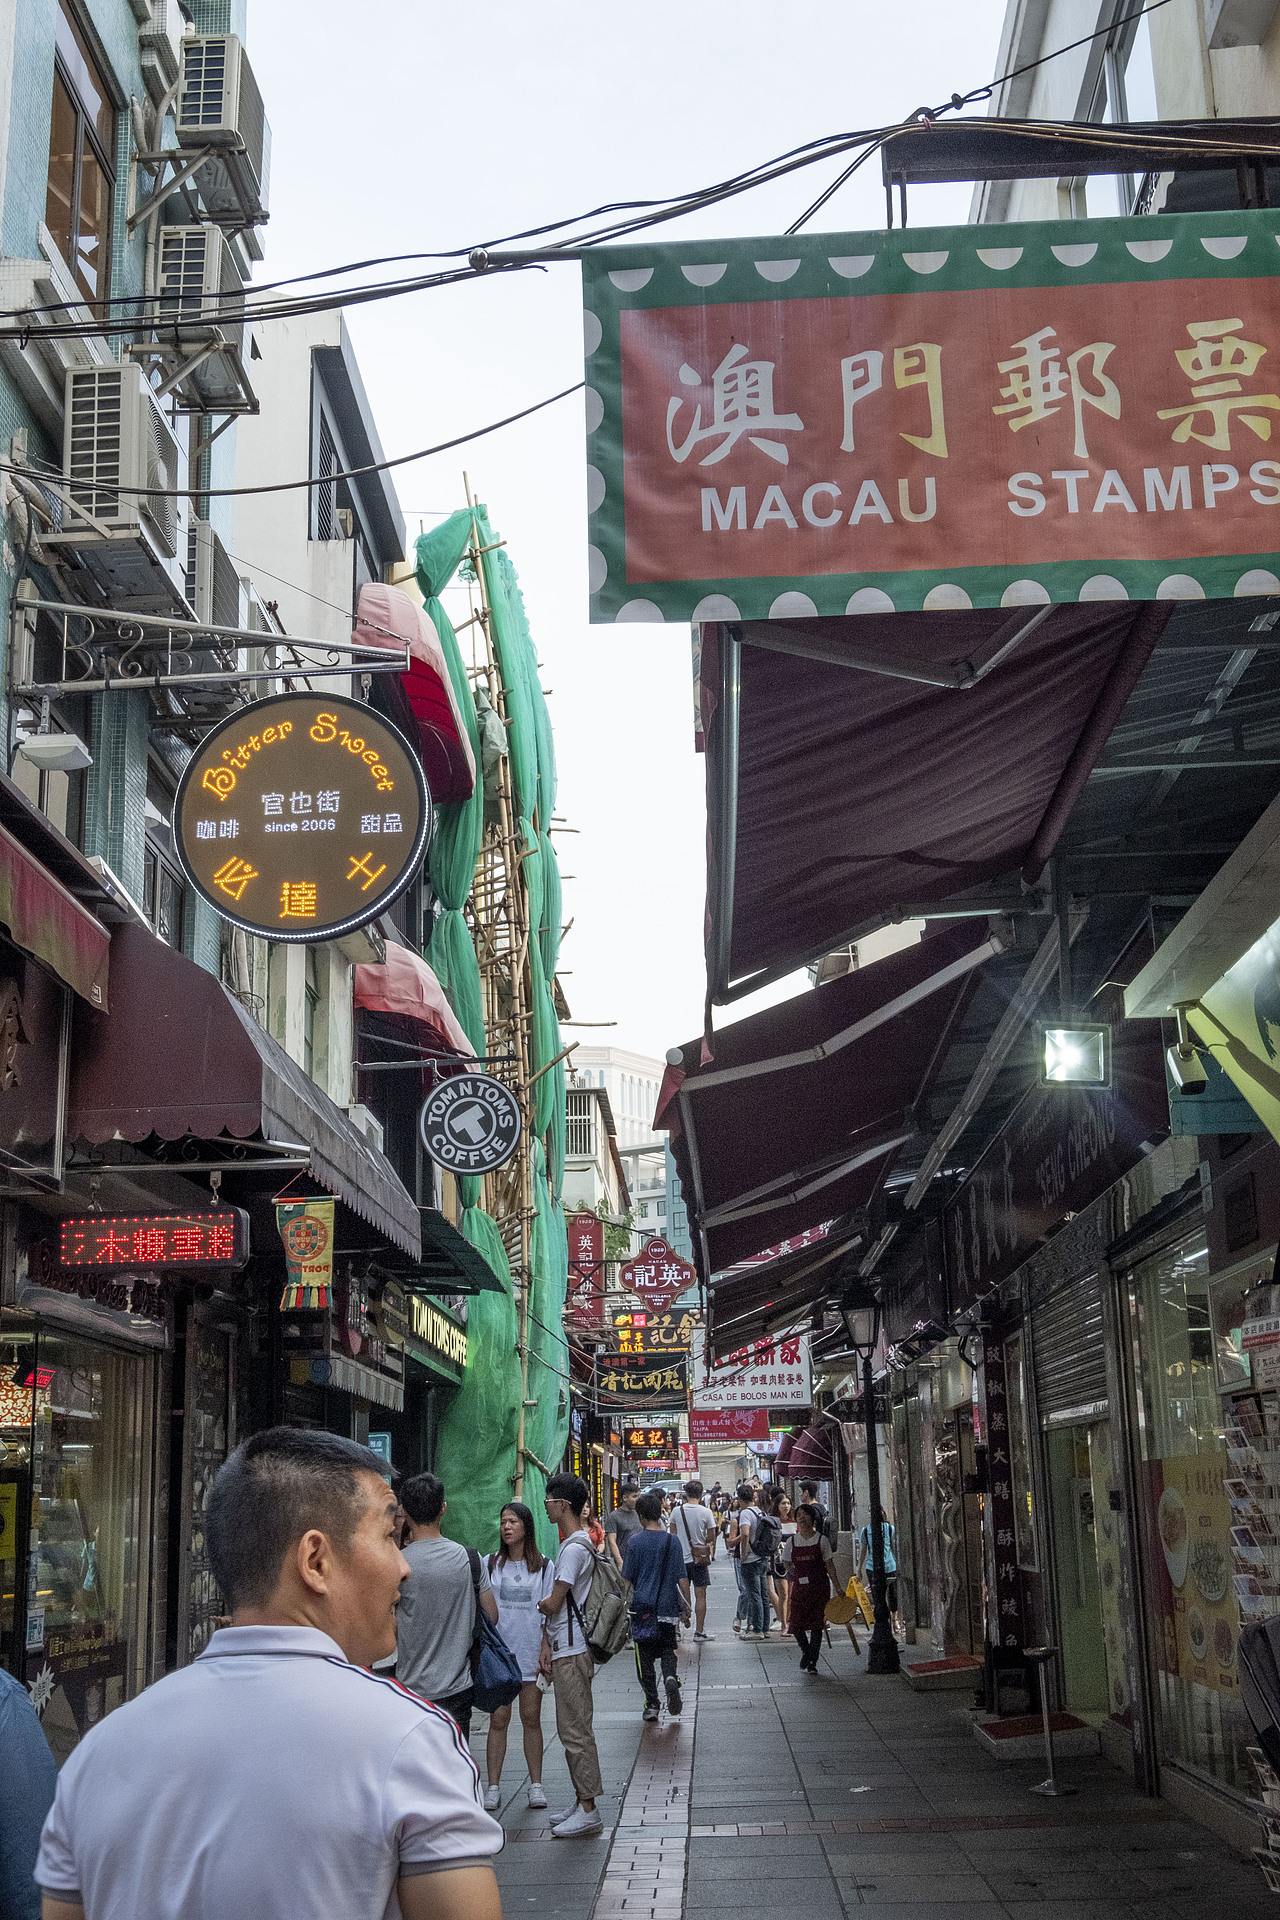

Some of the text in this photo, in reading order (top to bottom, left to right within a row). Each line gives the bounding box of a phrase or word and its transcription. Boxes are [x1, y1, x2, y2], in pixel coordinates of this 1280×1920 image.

[666, 317, 1280, 466] 澳門郵票
[700, 459, 1280, 532] MACAU STAMPS
[203, 713, 394, 801] Bitter Sweet
[261, 790, 340, 816] 官也街
[196, 819, 240, 839] 咖啡
[264, 819, 336, 832] since 2006
[361, 813, 403, 834] 甜品
[431, 1133, 508, 1166] COFFEE
[74, 1224, 234, 1263] 木糠雪糕
[702, 1390, 804, 1402] CASA DE BOLOS MAN KEI
[629, 1430, 665, 1446] 鉅記
